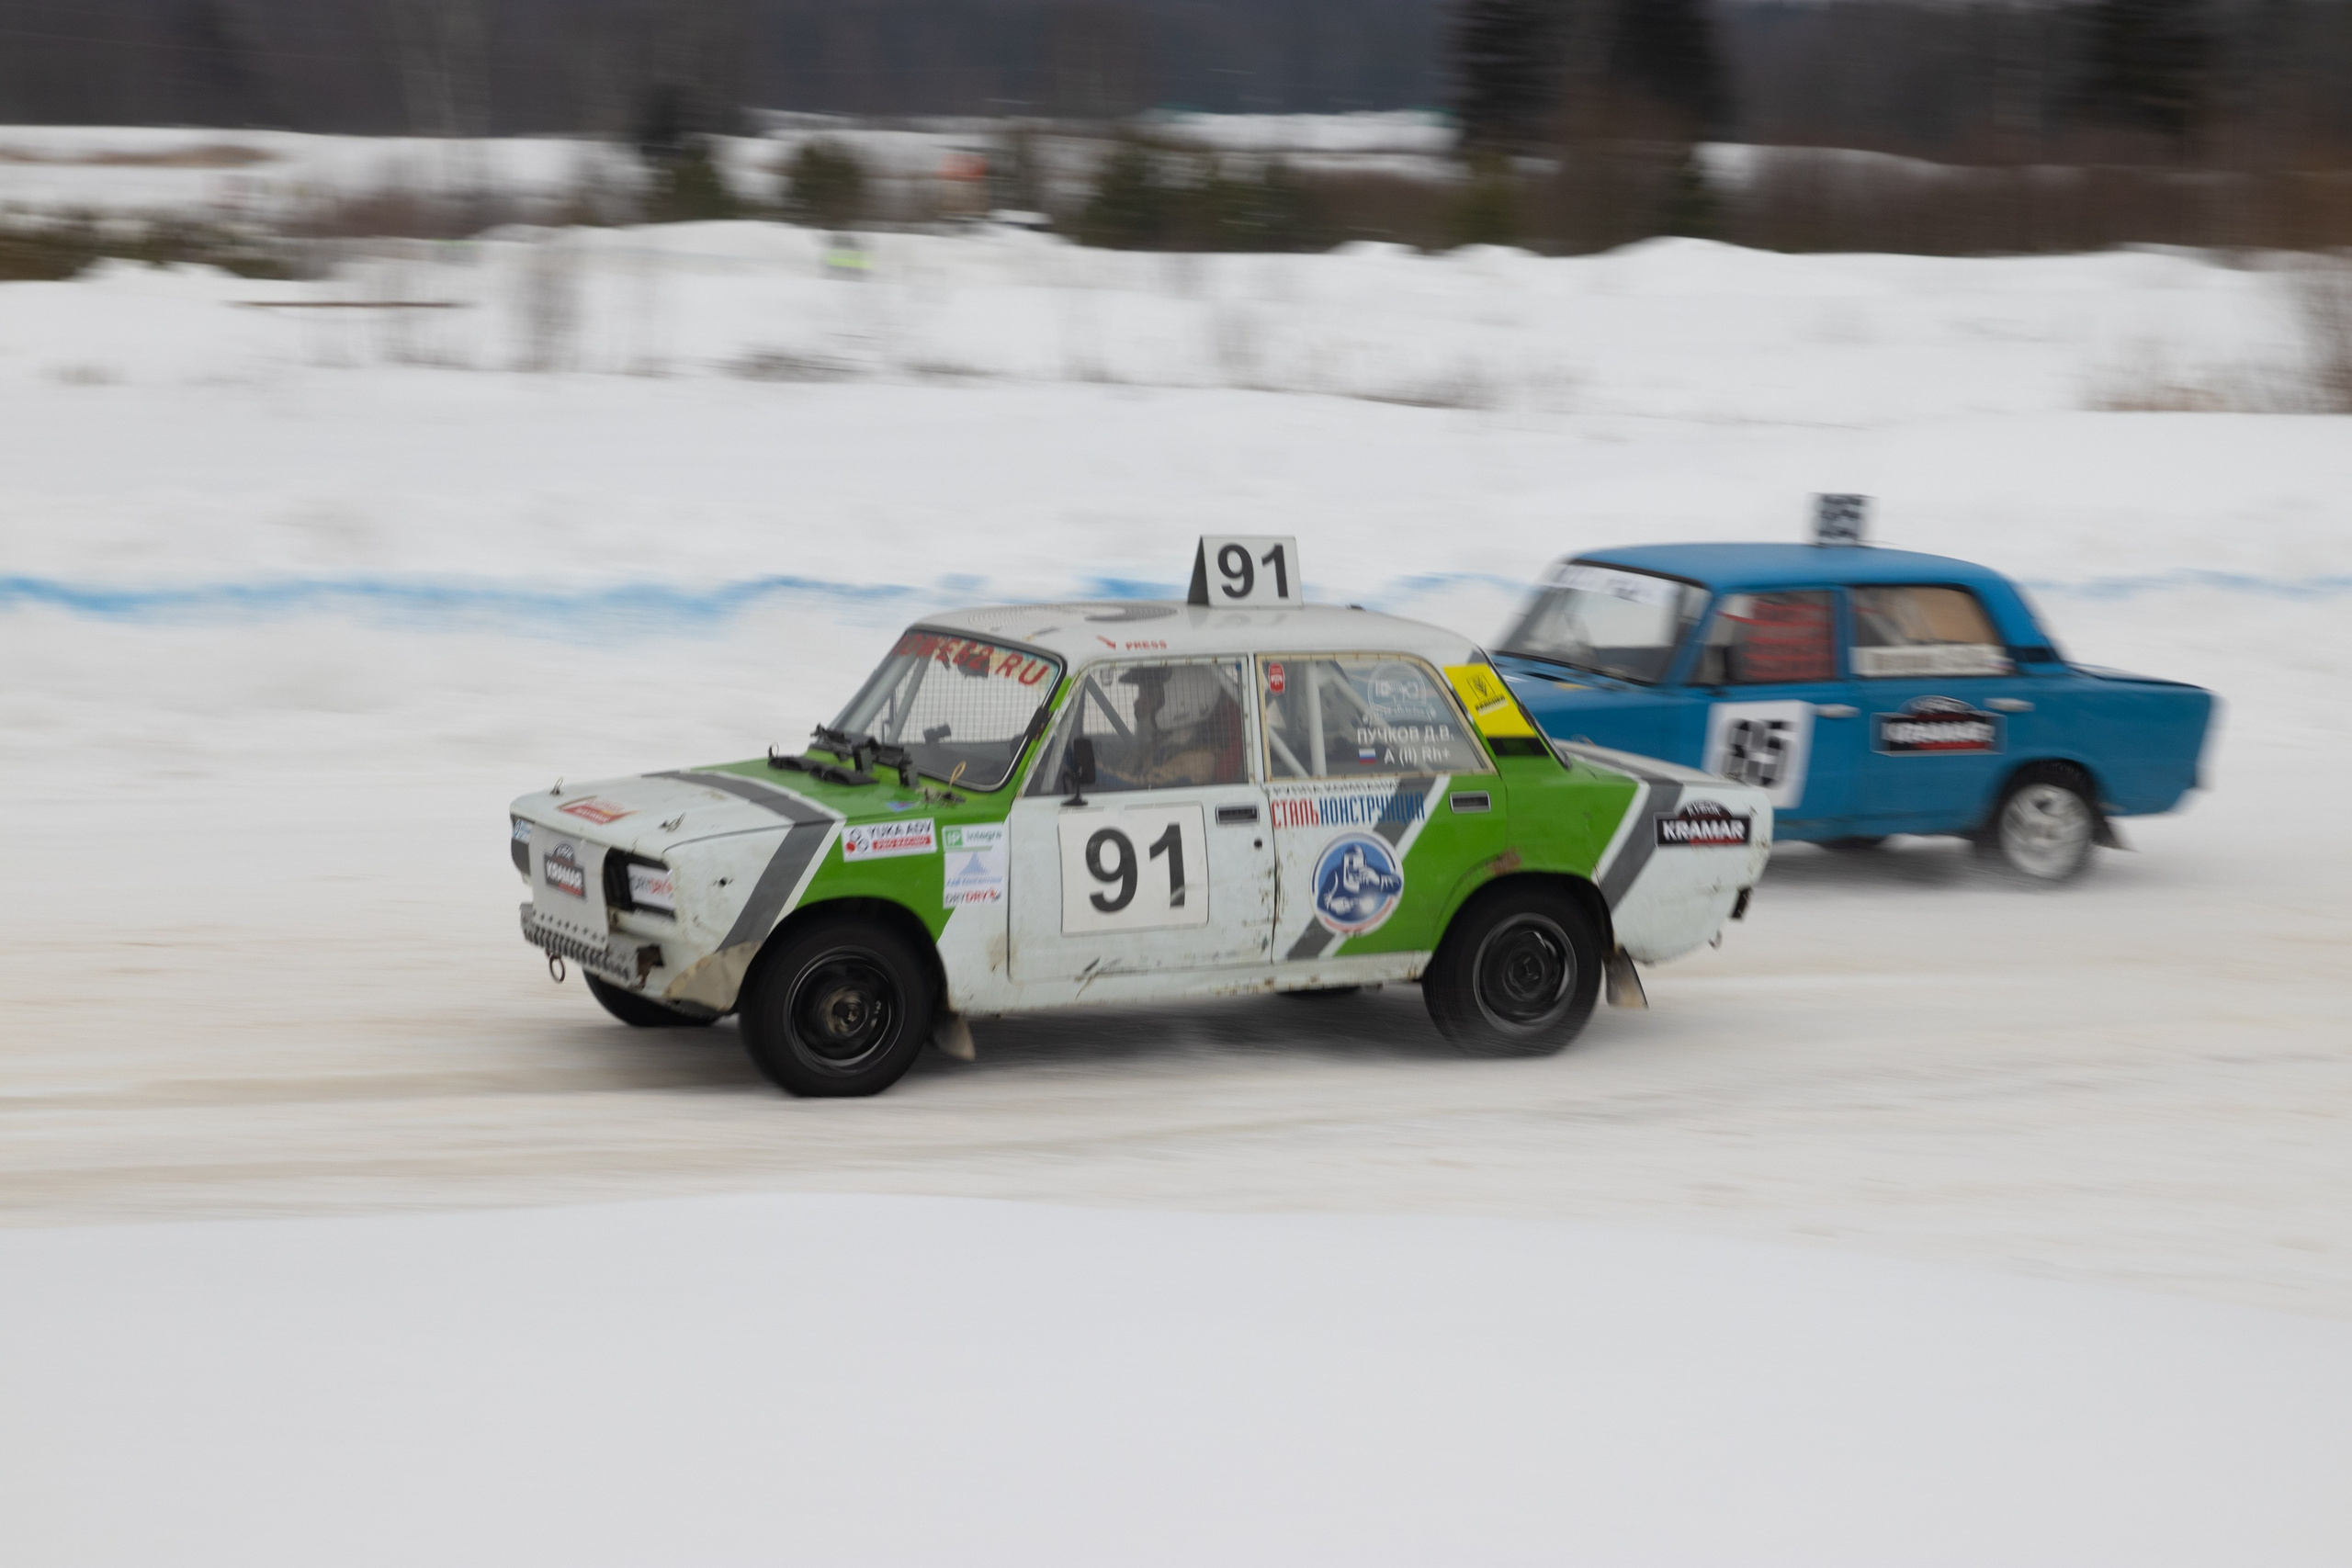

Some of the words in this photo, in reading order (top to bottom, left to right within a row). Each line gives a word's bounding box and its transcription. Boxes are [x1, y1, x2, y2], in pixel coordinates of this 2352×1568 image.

[1217, 542, 1289, 599] 91
[1125, 639, 1168, 650] PRESS
[1357, 726, 1420, 745] ПУЧКОВ
[1422, 745, 1451, 762] Rh+
[1725, 717, 1795, 789] 85
[1271, 792, 1426, 829] СТАЛЬКОНСТРУКЦИЯ
[1661, 819, 1746, 840] KRAMAR
[1086, 821, 1186, 913] 91
